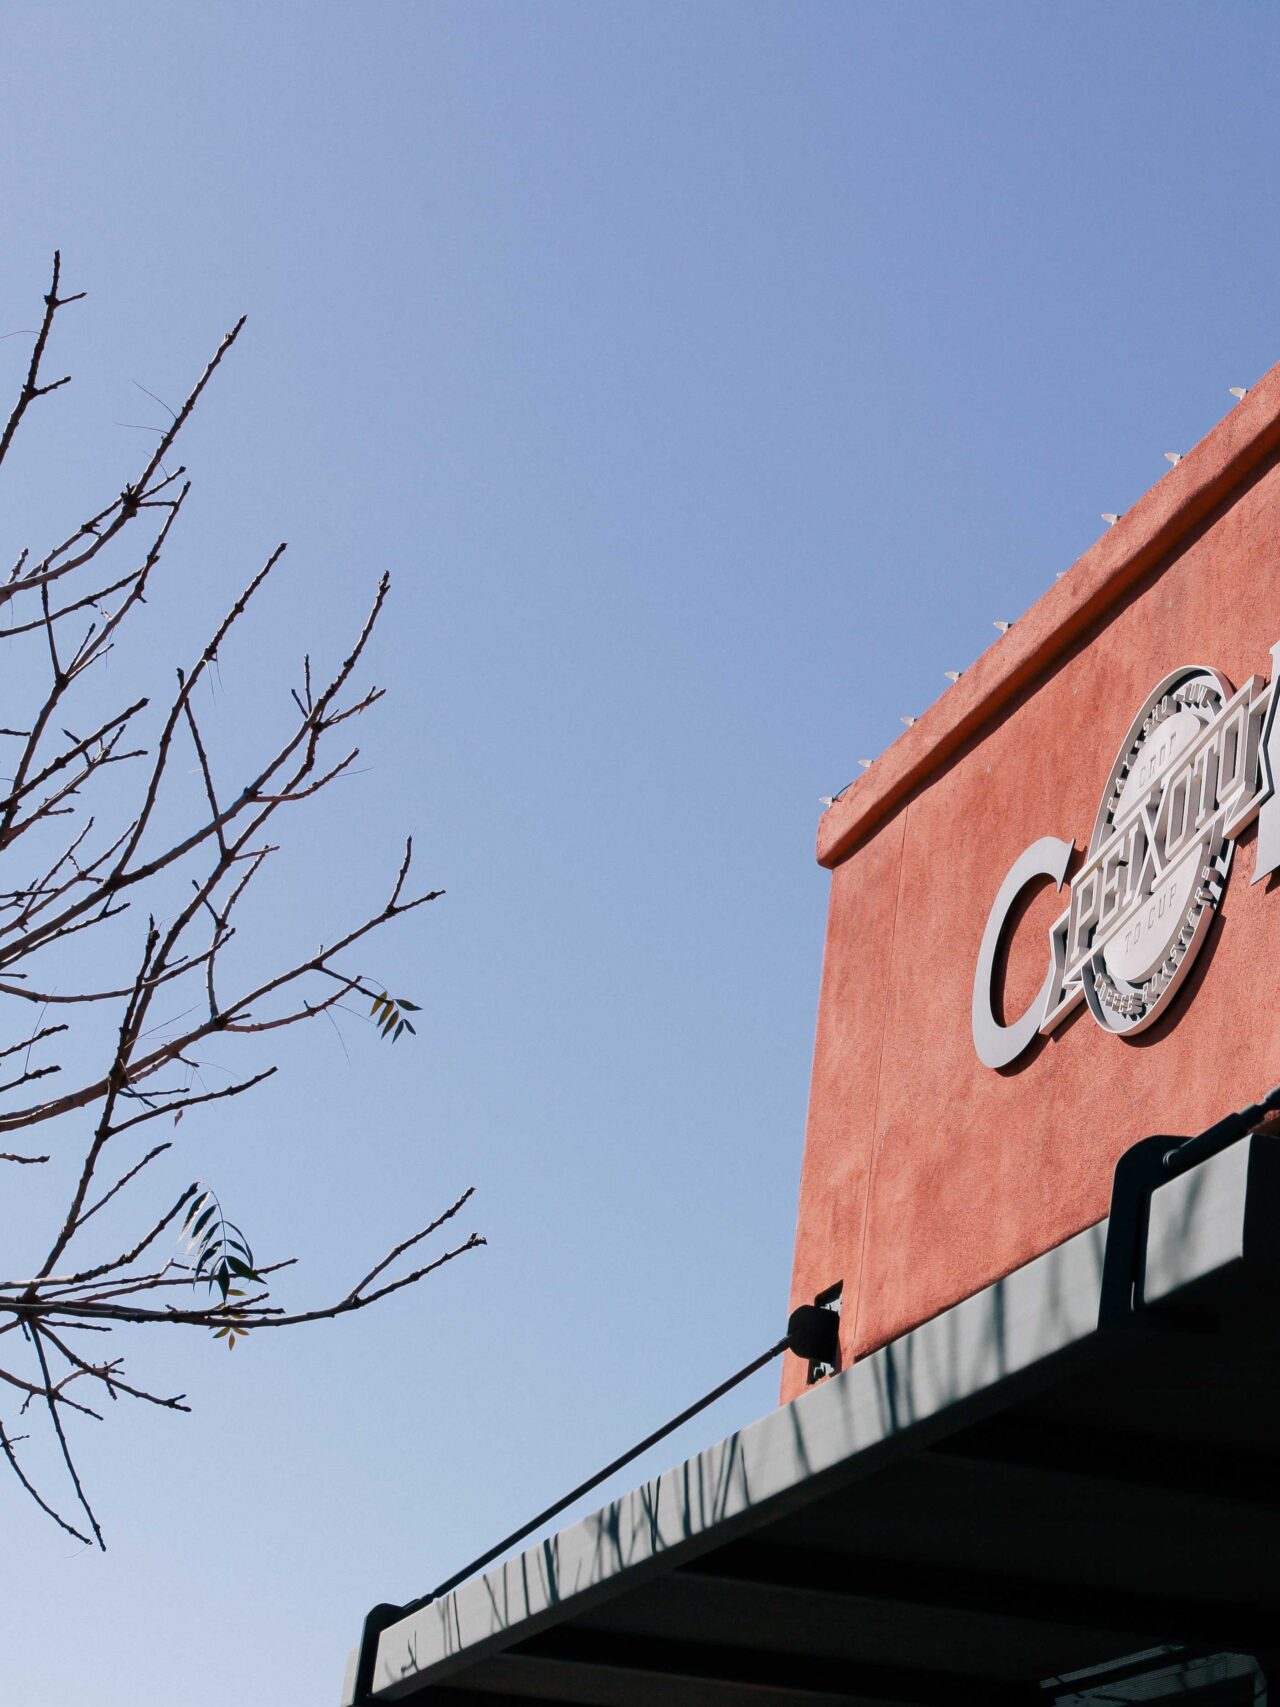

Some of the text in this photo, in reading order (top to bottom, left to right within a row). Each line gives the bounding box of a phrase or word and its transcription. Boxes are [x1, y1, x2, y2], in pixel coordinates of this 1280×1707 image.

[1139, 731, 1177, 788] CROP
[1069, 703, 1246, 958] PEIXOTO
[1093, 866, 1211, 1014] COFFEE ROASTERS
[1124, 882, 1178, 955] TO CUP
